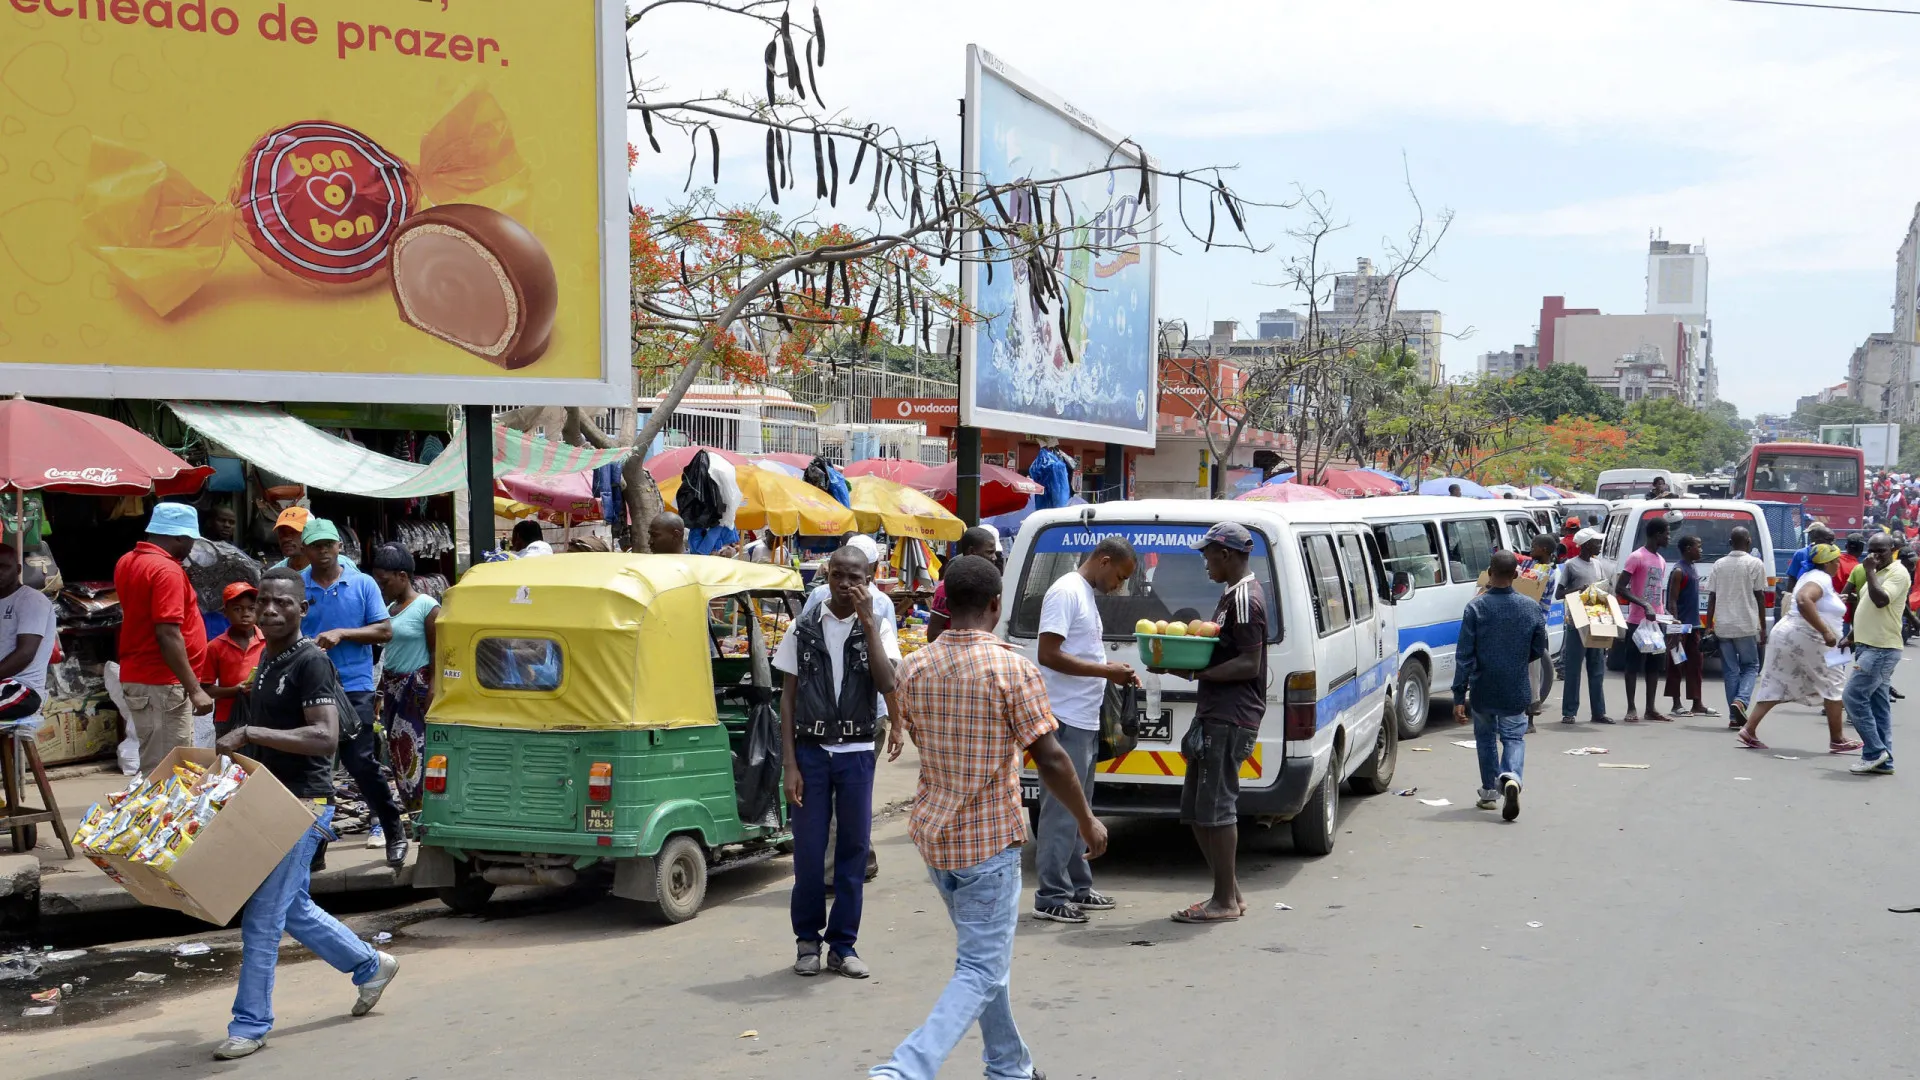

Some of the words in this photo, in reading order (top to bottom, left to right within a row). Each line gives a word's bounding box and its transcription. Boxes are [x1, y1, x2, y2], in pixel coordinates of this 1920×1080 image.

[258, 3, 318, 45] de
[337, 20, 509, 67] prazer.
[288, 149, 353, 177] bon
[309, 215, 375, 243] bon
[444, 670, 461, 678] ARKS
[433, 730, 449, 741] GN
